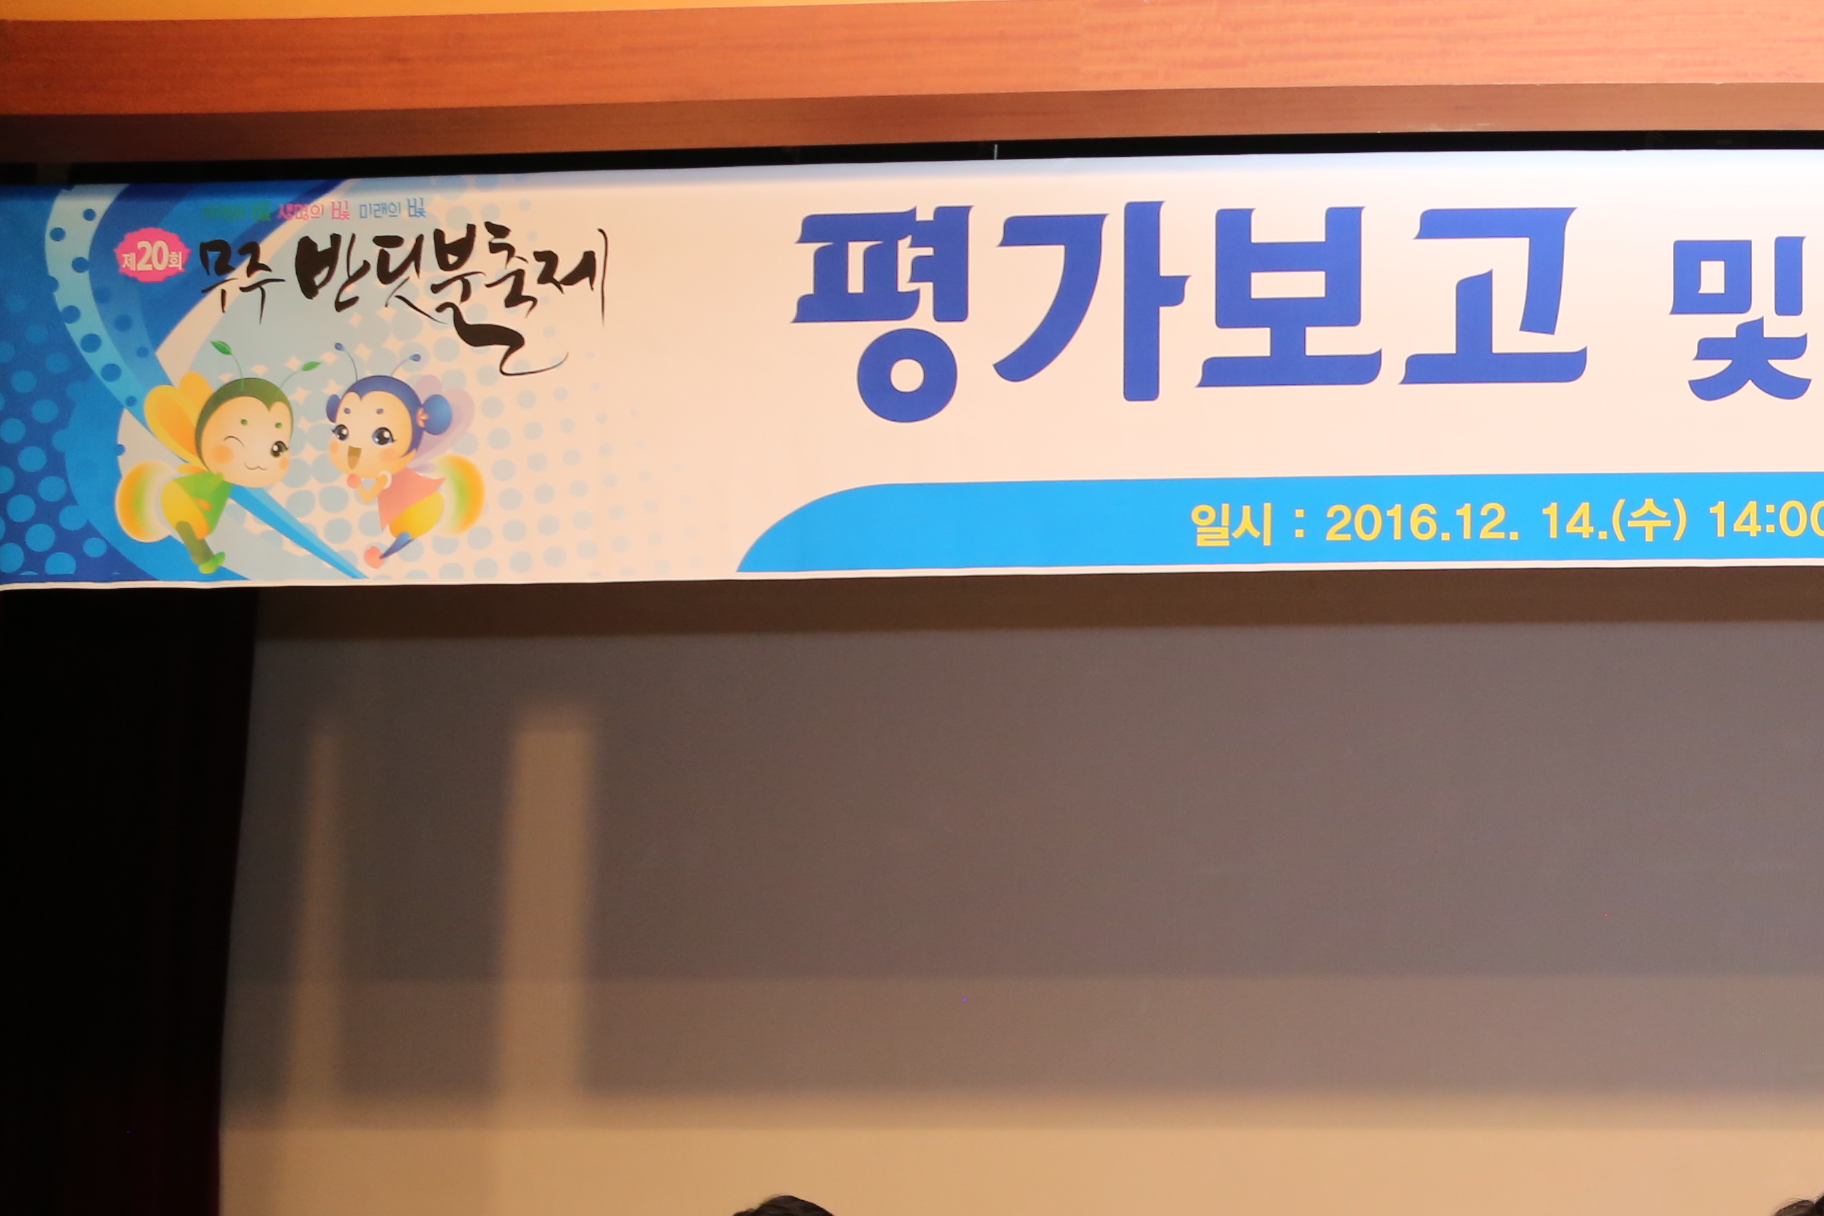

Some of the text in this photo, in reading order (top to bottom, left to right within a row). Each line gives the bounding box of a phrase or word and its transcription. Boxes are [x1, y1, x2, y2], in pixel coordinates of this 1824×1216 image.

[276, 202, 325, 222] 생명의
[330, 199, 351, 221] 빛
[358, 201, 402, 220] 미래의
[406, 196, 427, 219] 빛
[122, 240, 182, 271] 제20회
[198, 236, 287, 325] 무주
[794, 201, 1587, 423] 평가보고
[1670, 237, 1811, 401] 및
[1191, 502, 1272, 547] 일시
[1326, 502, 1519, 541] 2016.12.
[1542, 498, 1687, 542] 14.(수)
